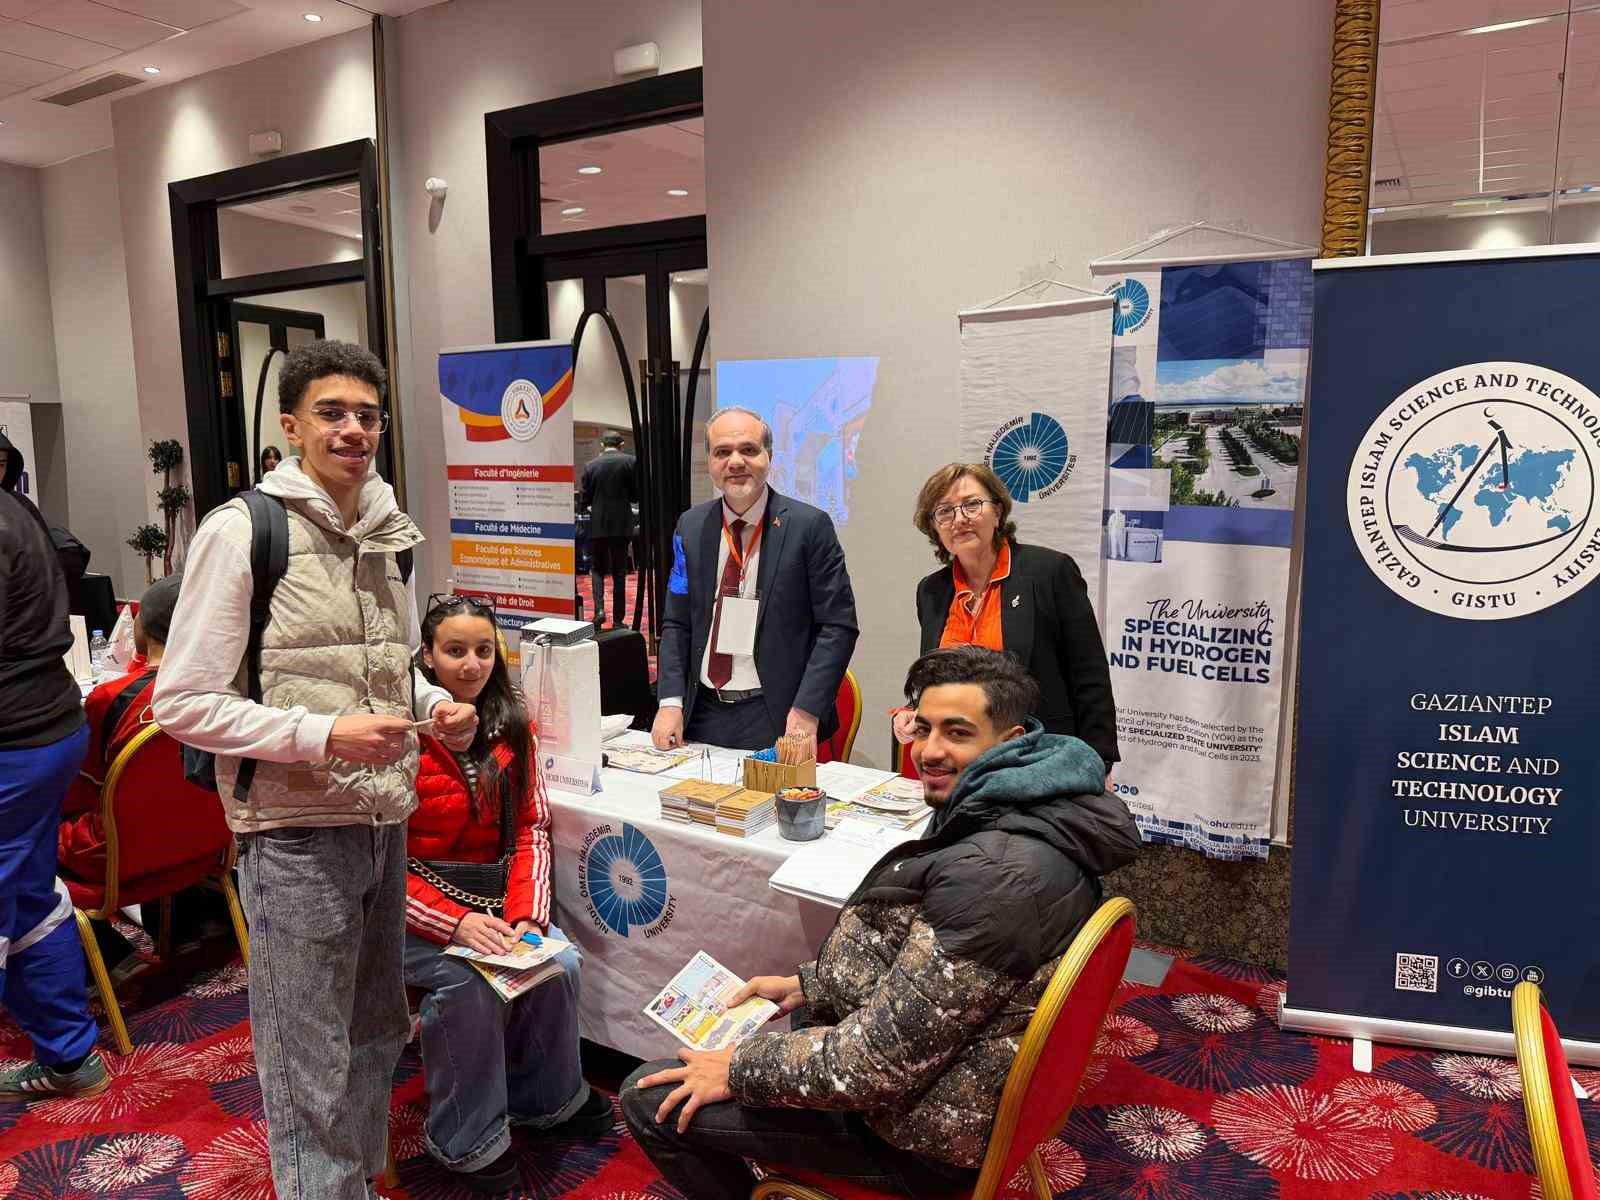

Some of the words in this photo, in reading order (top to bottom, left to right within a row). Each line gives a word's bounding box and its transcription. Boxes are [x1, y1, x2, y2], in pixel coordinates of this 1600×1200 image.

[1360, 431, 1393, 489] ISLAM
[1389, 378, 1468, 431] SCIENCE
[1474, 373, 1519, 389] AND
[1525, 377, 1600, 447] TECHNOL
[499, 523, 509, 532] de
[518, 597, 535, 608] Droit
[1451, 591, 1517, 609] GISTU
[1147, 598, 1178, 620] The
[1181, 599, 1274, 633] University
[1124, 618, 1273, 647] SPECIALIZING
[1121, 635, 1142, 652] IN
[1150, 637, 1271, 665] HYDROGEN
[1110, 652, 1140, 669] ND
[1147, 656, 1198, 677] FUEL
[1201, 664, 1270, 684] CELLS
[1410, 693, 1552, 715] GAZIANTEP
[1127, 707, 1167, 719] University
[1169, 713, 1183, 722] has
[1200, 722, 1236, 733] selected
[1237, 725, 1247, 735] by
[1249, 726, 1265, 734] the
[1136, 719, 1145, 727] of
[1146, 720, 1175, 732] Higher
[1248, 735, 1264, 743] the
[1128, 727, 1185, 741] SPECIALIZED
[1186, 735, 1205, 747] STATE
[1438, 723, 1520, 745] ISLAM
[1137, 737, 1178, 751] Hydrogen
[1208, 752, 1229, 761] Cells
[1397, 751, 1501, 773] SCIENCE
[1506, 757, 1560, 776] AND
[1391, 780, 1563, 806] TECHNOLOGY
[1126, 800, 1154, 811] ersitesi
[1403, 809, 1552, 835] UNIVERSITY
[618, 874, 634, 886] 1992
[643, 893, 677, 938] UNIVERSITY
